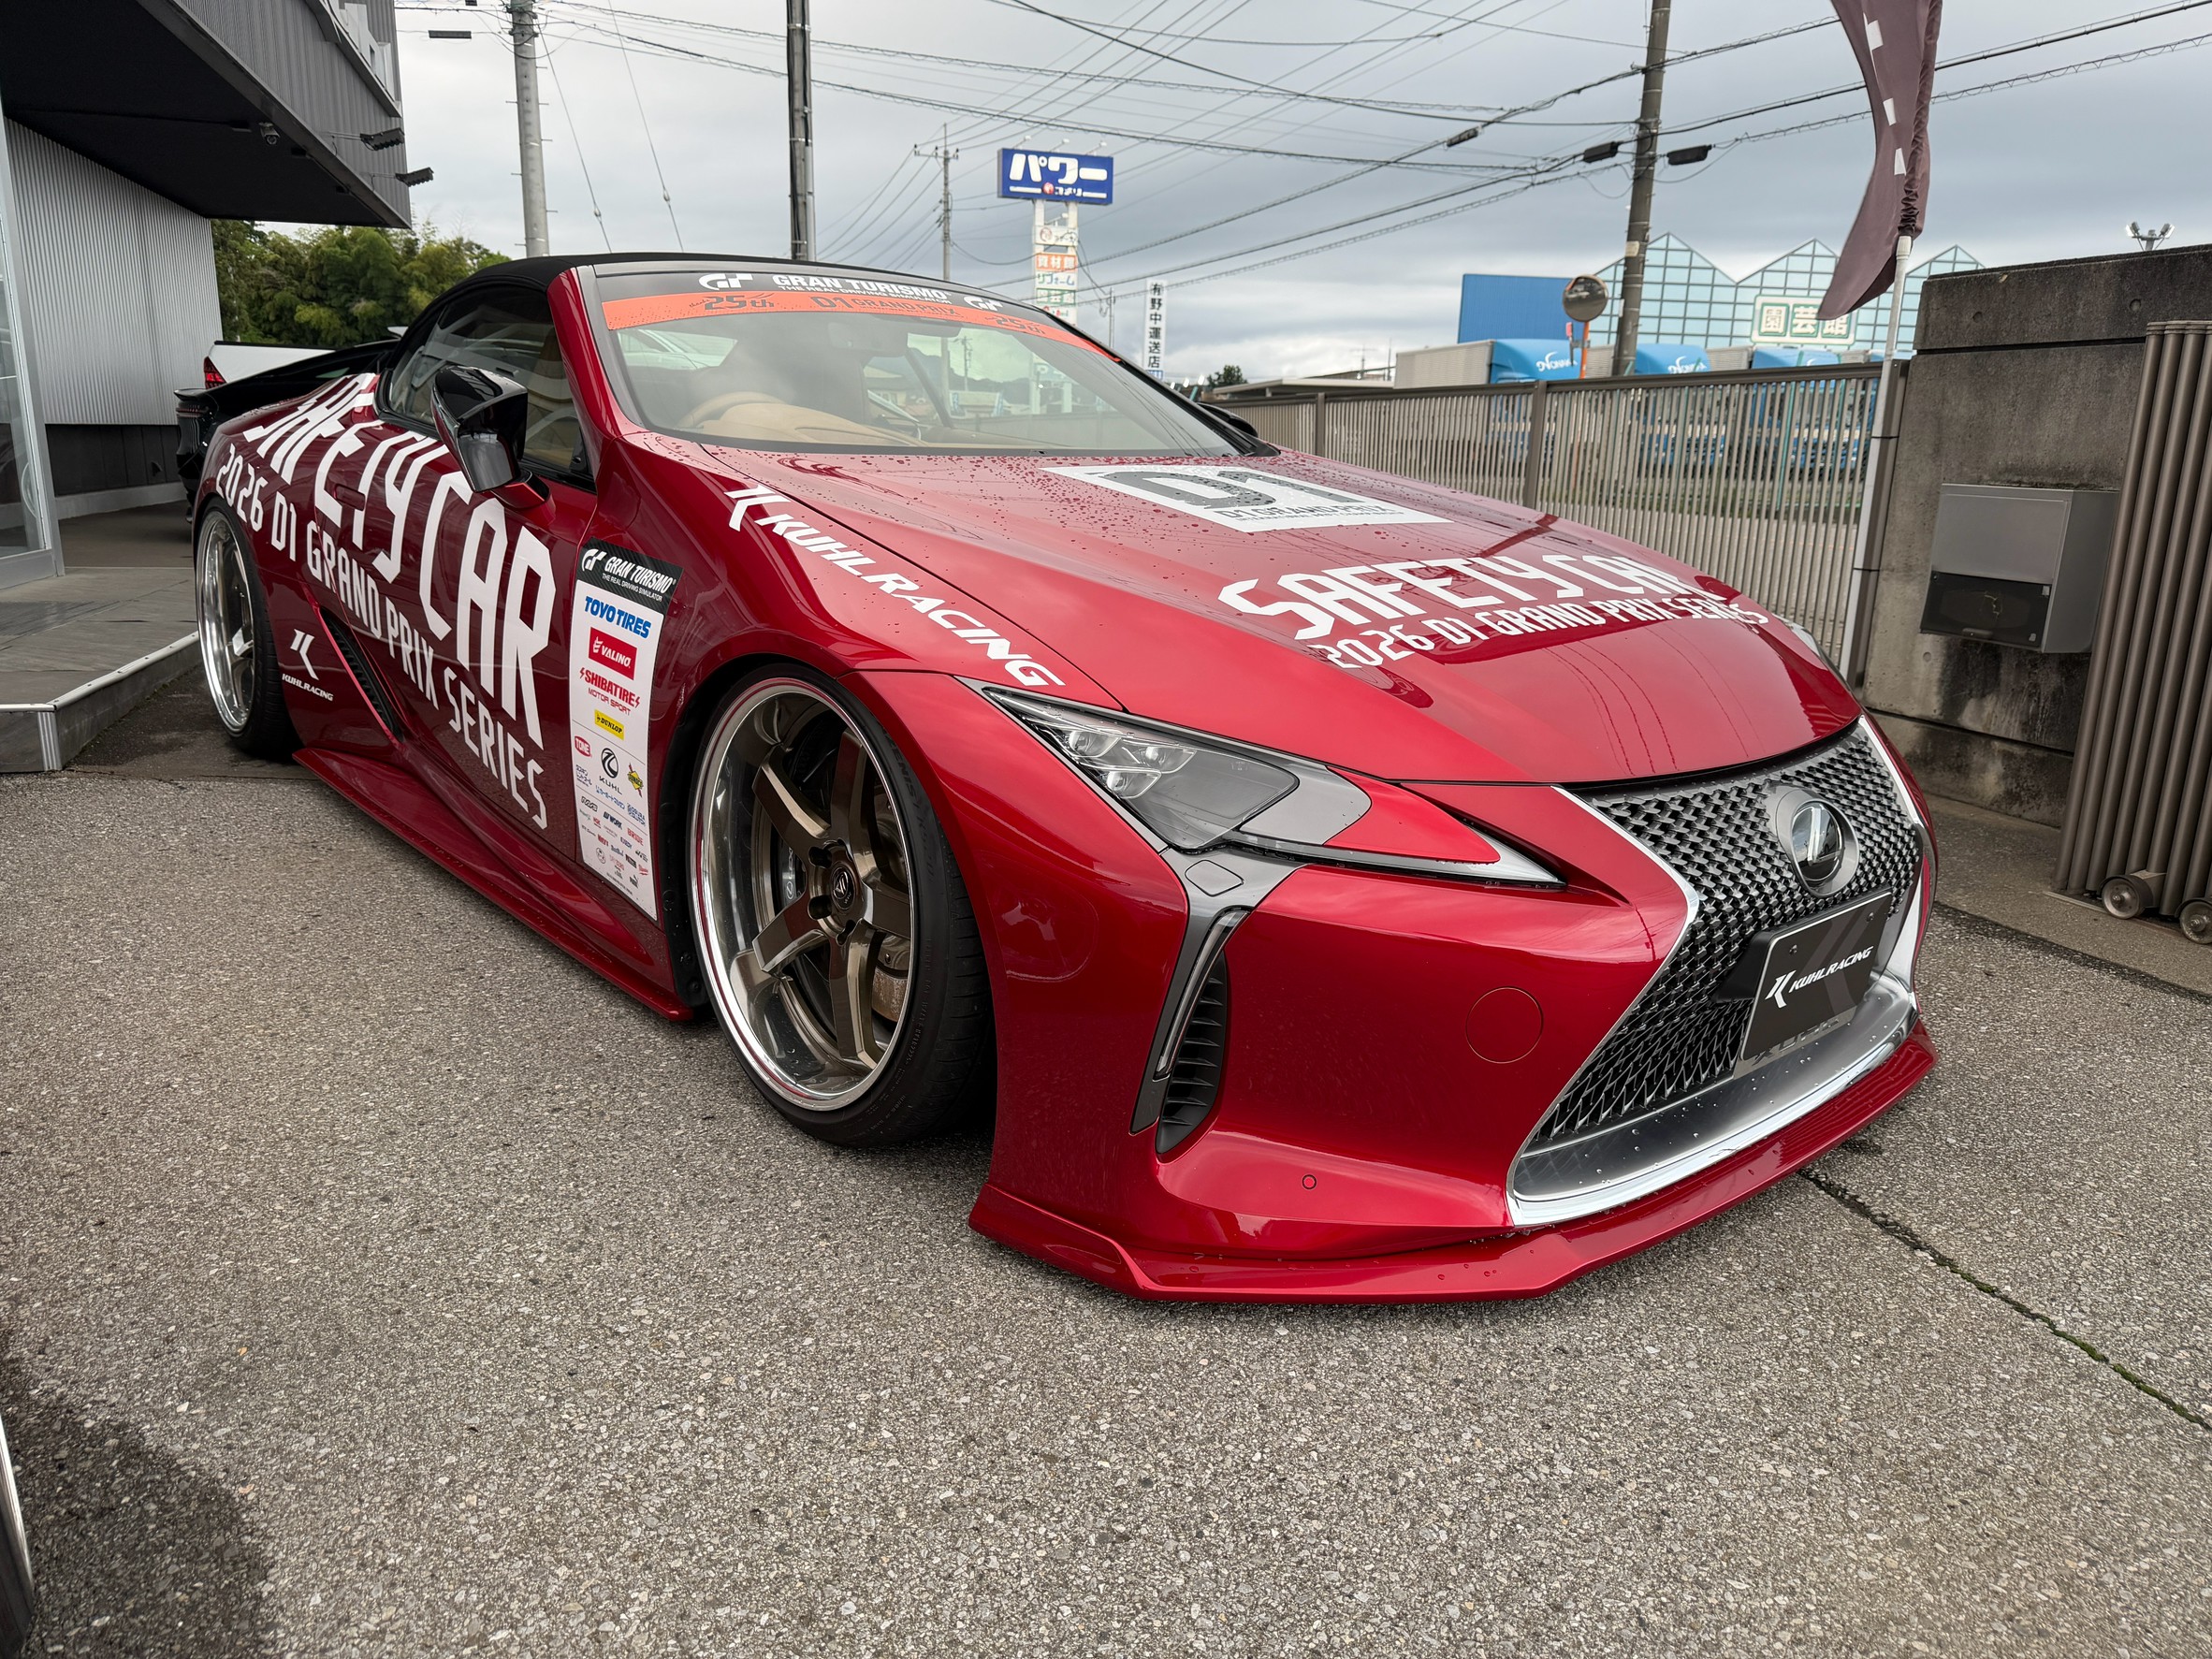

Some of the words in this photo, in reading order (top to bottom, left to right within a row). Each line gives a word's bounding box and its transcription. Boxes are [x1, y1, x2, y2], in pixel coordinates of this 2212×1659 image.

[1010, 153, 1107, 184] パワー
[773, 274, 840, 289] GRAN
[845, 278, 948, 300] TURISMO
[809, 295, 853, 310] D1
[851, 298, 917, 312] GRAND
[1085, 469, 1366, 509] D1
[1252, 505, 1336, 517] GRAND
[602, 573, 610, 582] THE
[610, 575, 622, 587] REAL
[604, 556, 633, 579] GRAN
[631, 565, 674, 594] TURISMO
[419, 470, 557, 750] CAR
[1217, 555, 1584, 640] SAFETY
[585, 595, 618, 623] TOYO
[617, 610, 652, 639] TIRES
[215, 443, 269, 532] 2026
[271, 491, 298, 563] D1
[306, 520, 382, 640] GRAND
[386, 596, 440, 711] PRIX
[444, 666, 548, 831] SERIES
[1307, 624, 1435, 669] 2026
[1420, 617, 1491, 646] D1
[1474, 602, 1607, 637] GRAND
[1589, 598, 1682, 623] PRIX
[1661, 598, 1769, 625] SERIES
[601, 646, 632, 668] VALINO
[589, 688, 609, 705] MOTOR
[610, 697, 632, 717] SPORT
[601, 716, 623, 735] DUNLOP
[599, 776, 623, 795] KUHL
